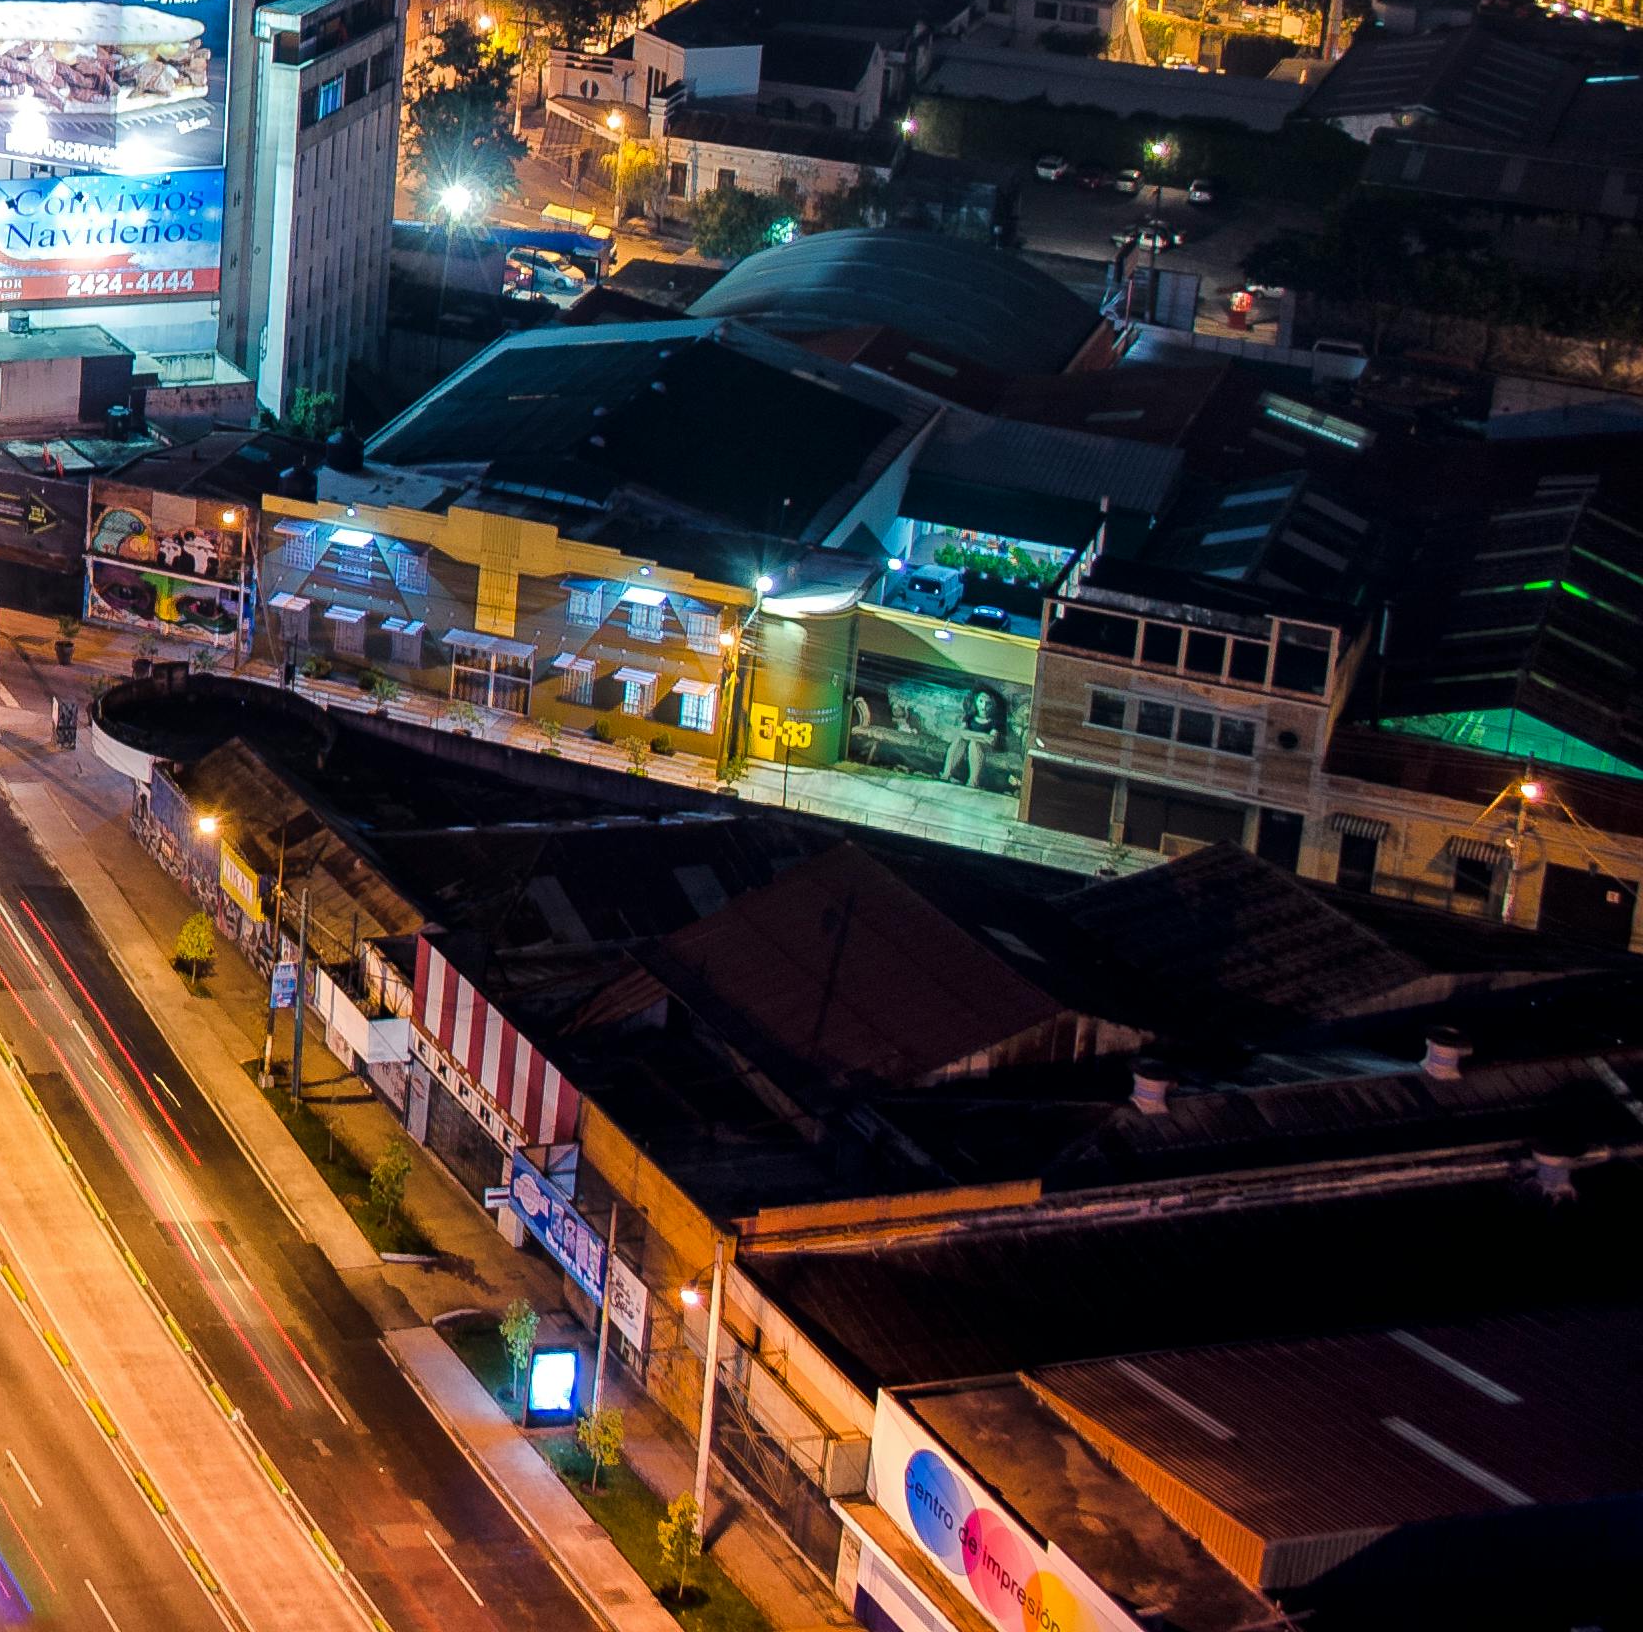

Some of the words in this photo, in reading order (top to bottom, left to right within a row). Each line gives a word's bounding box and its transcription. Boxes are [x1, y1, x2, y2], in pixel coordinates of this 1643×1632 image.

[13, 184, 205, 218] Convivios
[5, 216, 205, 250] Navideños
[66, 270, 195, 296] 2424-4444
[905, 1467, 955, 1530] Centro
[957, 1523, 979, 1556] de
